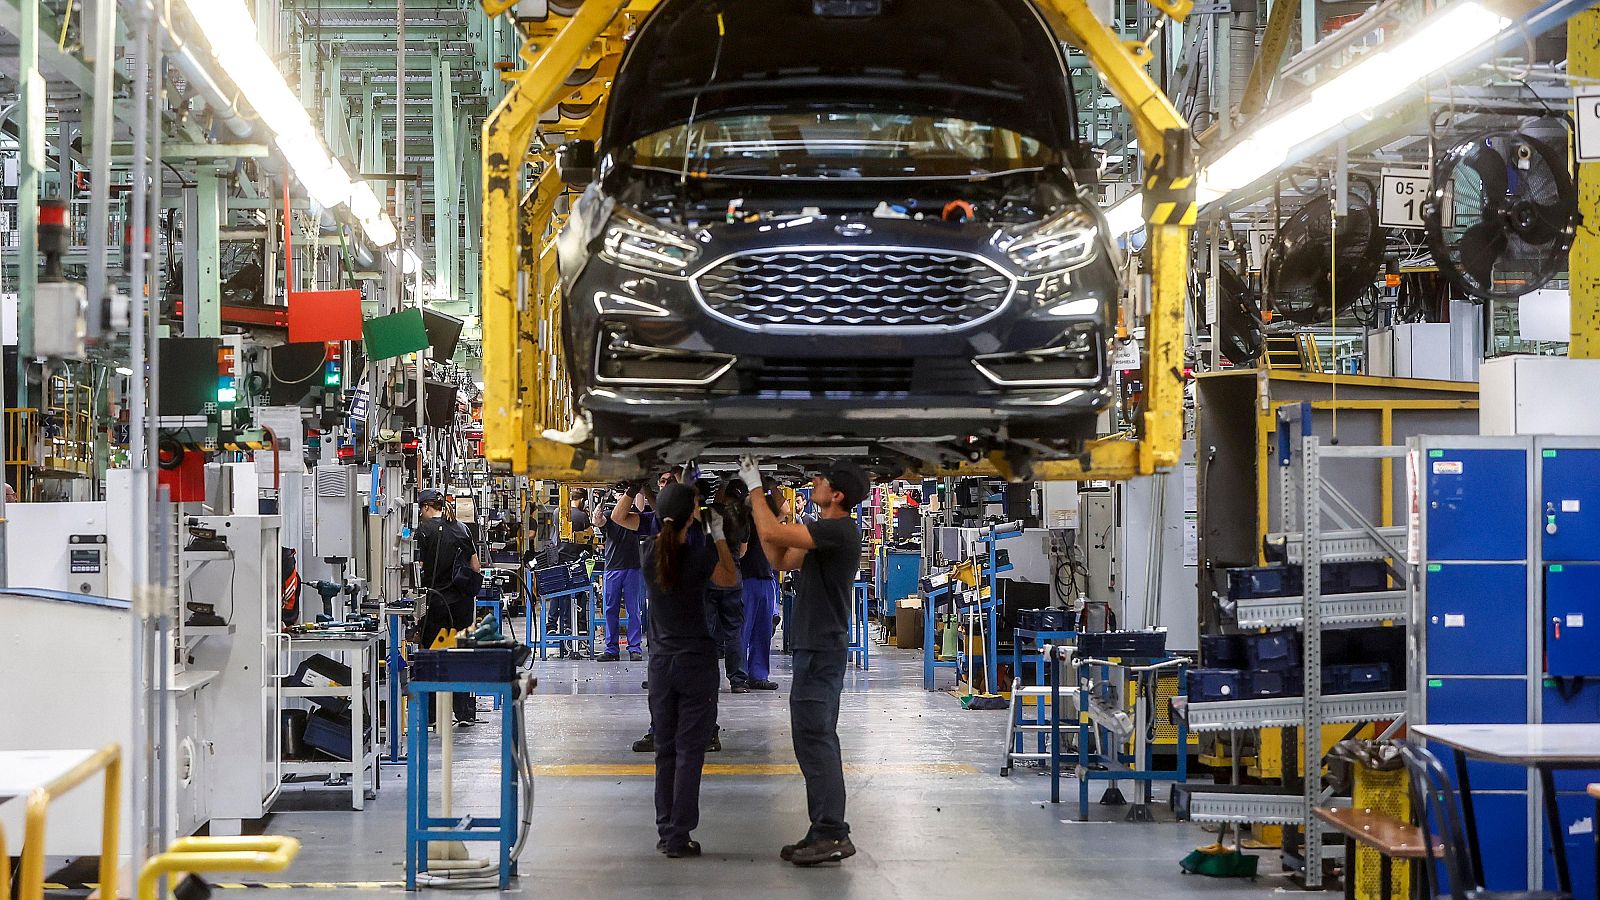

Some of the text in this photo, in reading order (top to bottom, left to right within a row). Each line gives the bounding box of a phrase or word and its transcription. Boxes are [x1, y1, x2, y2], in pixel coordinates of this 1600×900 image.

[1396, 182, 1414, 195] 05
[121, 425, 128, 433] K
[121, 434, 127, 442] 7
